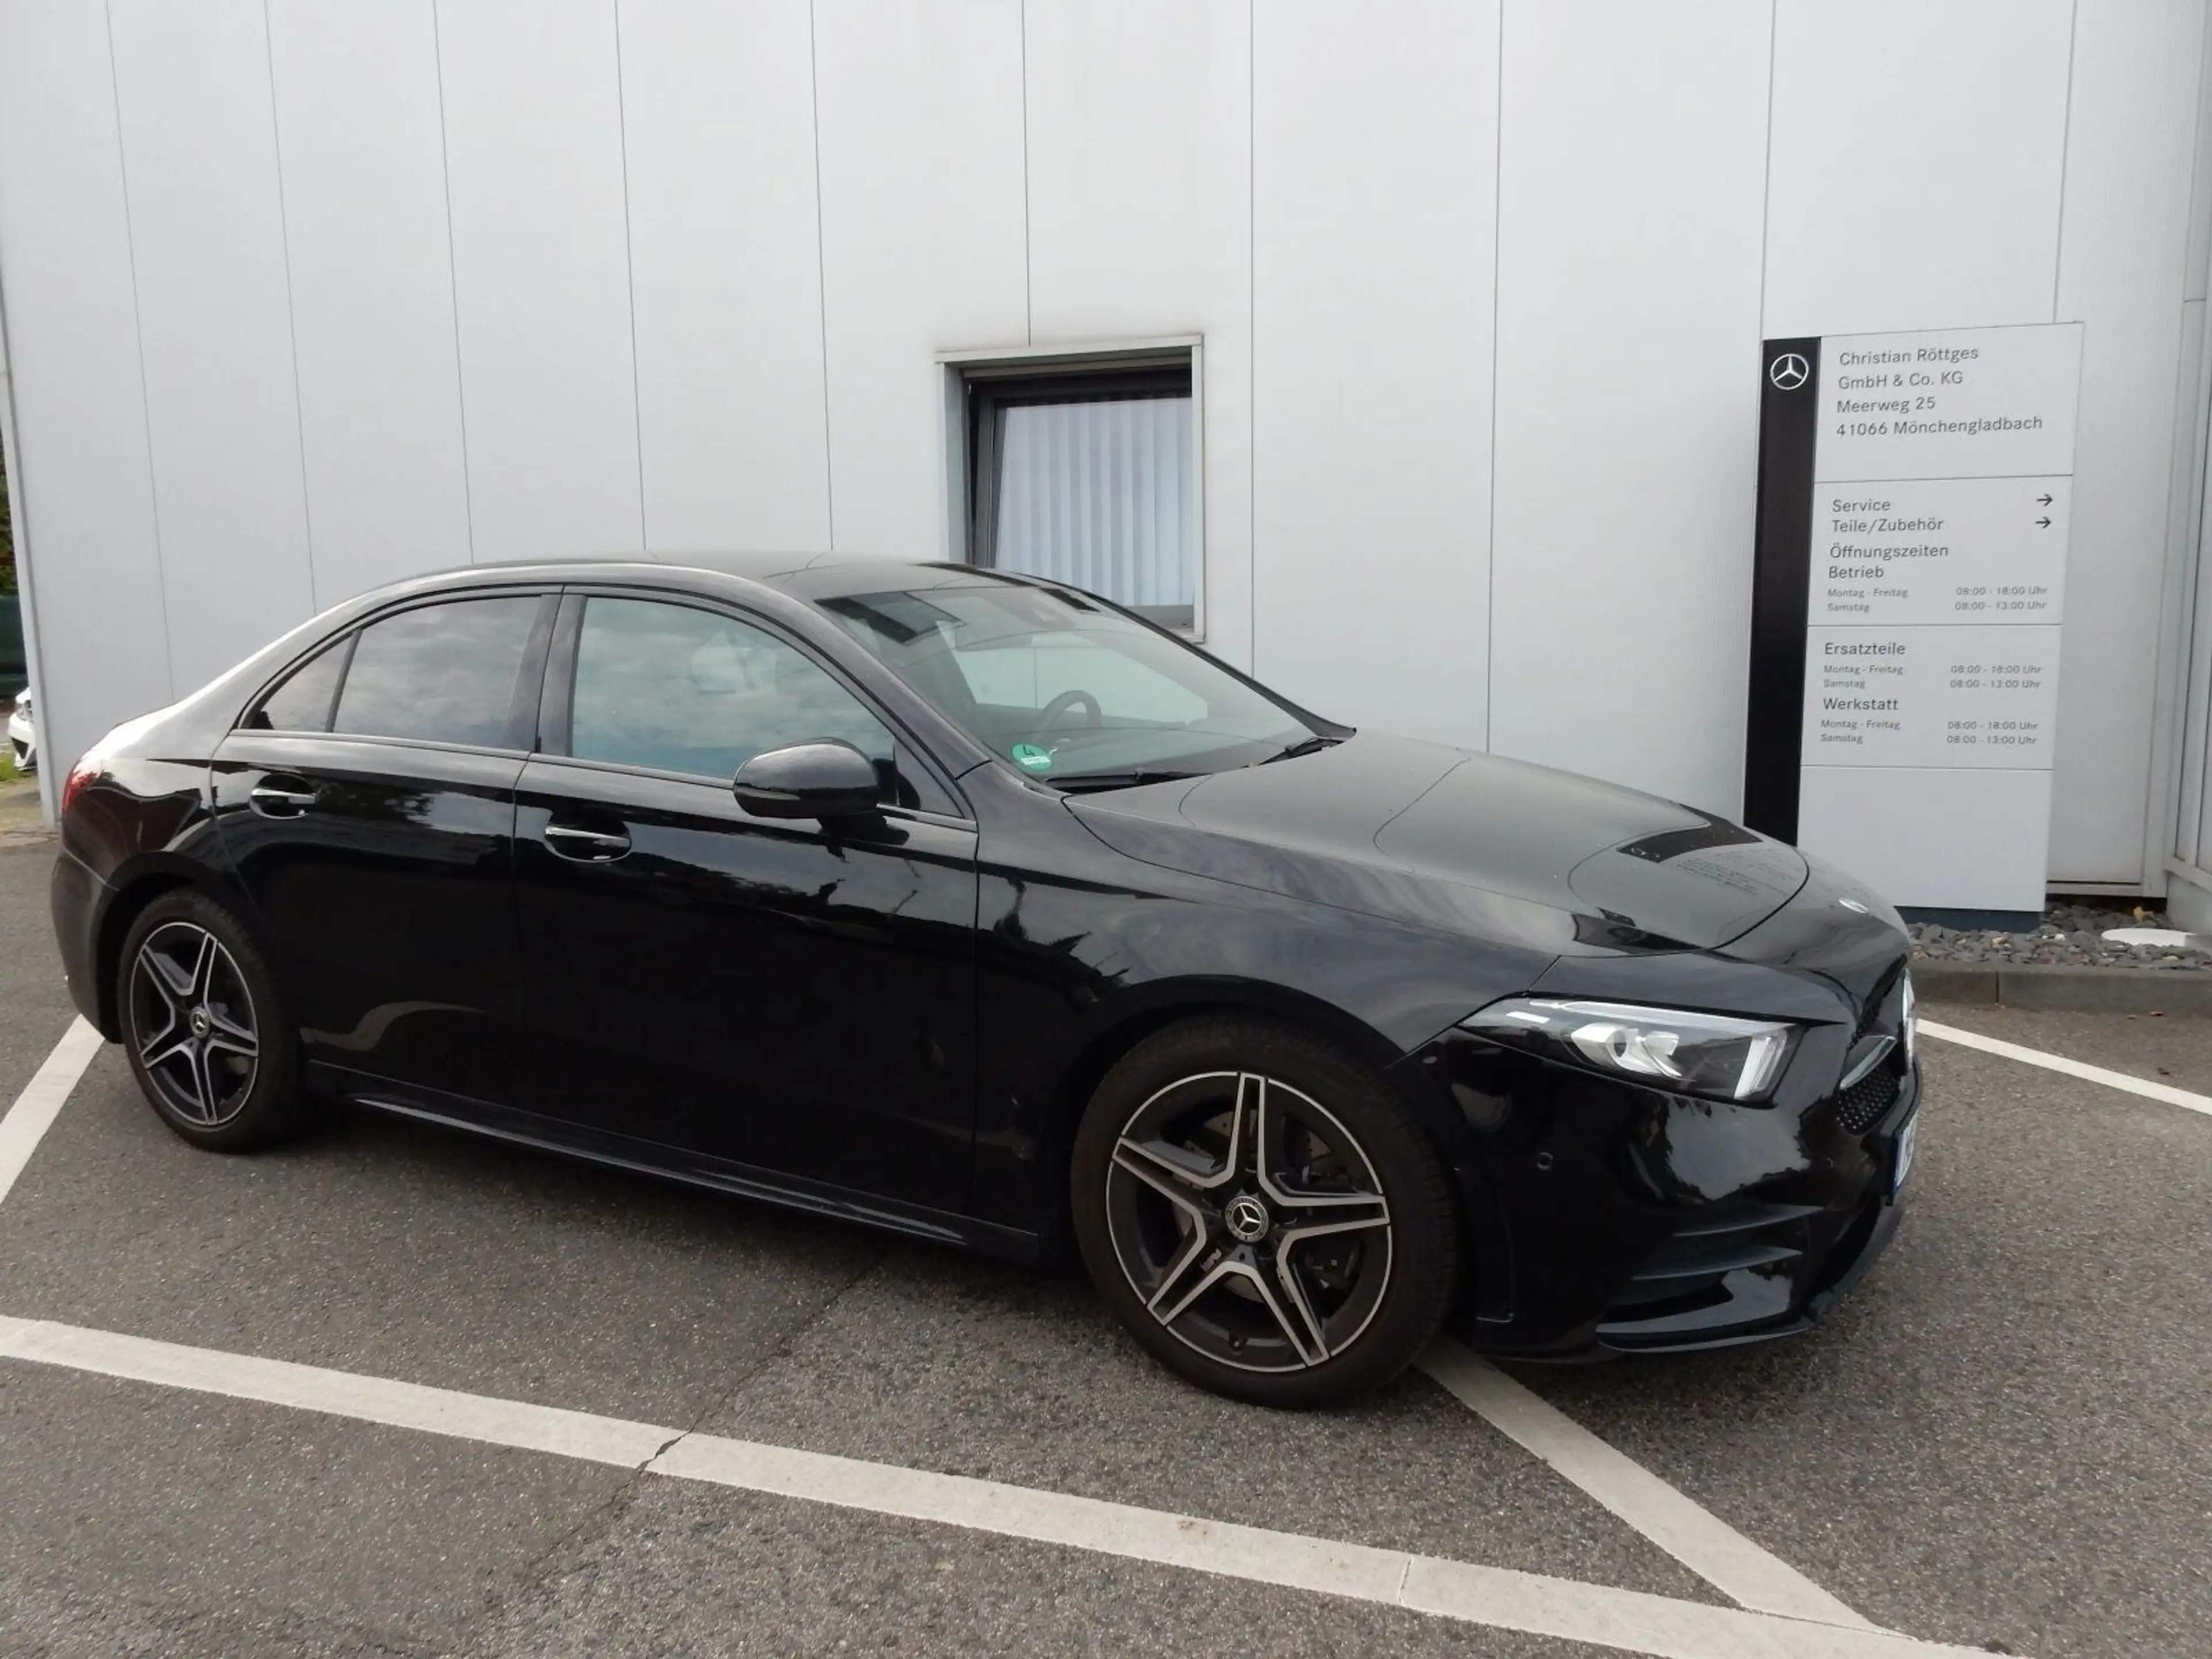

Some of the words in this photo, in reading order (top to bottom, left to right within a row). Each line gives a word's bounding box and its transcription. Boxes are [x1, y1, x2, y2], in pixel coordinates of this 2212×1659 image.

[1839, 351, 1911, 366] Christian
[1916, 347, 1979, 363] Röttges
[1838, 374, 1887, 390] GmbH
[1892, 374, 1903, 387] &
[1909, 373, 1934, 387] Co.
[1941, 372, 1963, 385] KG
[1836, 399, 1910, 414] Meerweg
[1916, 397, 1936, 410] 25
[1836, 422, 1888, 436] 41066
[1893, 416, 2043, 435] Mönchengladbach
[1832, 499, 1891, 513] Service
[1832, 518, 1944, 535] Teile/Zubehör
[1830, 542, 1949, 561] Öffnungszeiten
[1828, 566, 1884, 579] Betrieb
[1827, 588, 1865, 599] Montag
[1873, 588, 1909, 599] Freitag
[1956, 587, 1986, 596] 08:00
[2028, 586, 2047, 595] Uhr
[1827, 603, 1870, 613] Samstag
[2028, 601, 2047, 609] Uhr
[1824, 643, 1907, 656] Ersatzteile
[1823, 665, 1861, 675] Montag
[1869, 665, 1903, 676] Freitag
[1950, 665, 1981, 674] 08:00
[2022, 665, 2042, 674] Uhr
[1823, 679, 1865, 690] Samstag
[1950, 680, 1980, 688] 08:00
[1991, 680, 2019, 688] 13:00
[2022, 680, 2041, 688] Uhr
[1823, 698, 1899, 710] Werkstatt
[1820, 719, 1858, 730] Montag
[1866, 719, 1901, 730] Freitag
[1948, 721, 1977, 729] 08:00
[1988, 721, 2016, 729] 18:00
[1820, 734, 1863, 744] Samstag
[1946, 735, 1976, 743] 08:00
[1987, 736, 2016, 745] 13:00
[2018, 735, 2037, 745] Uhr
